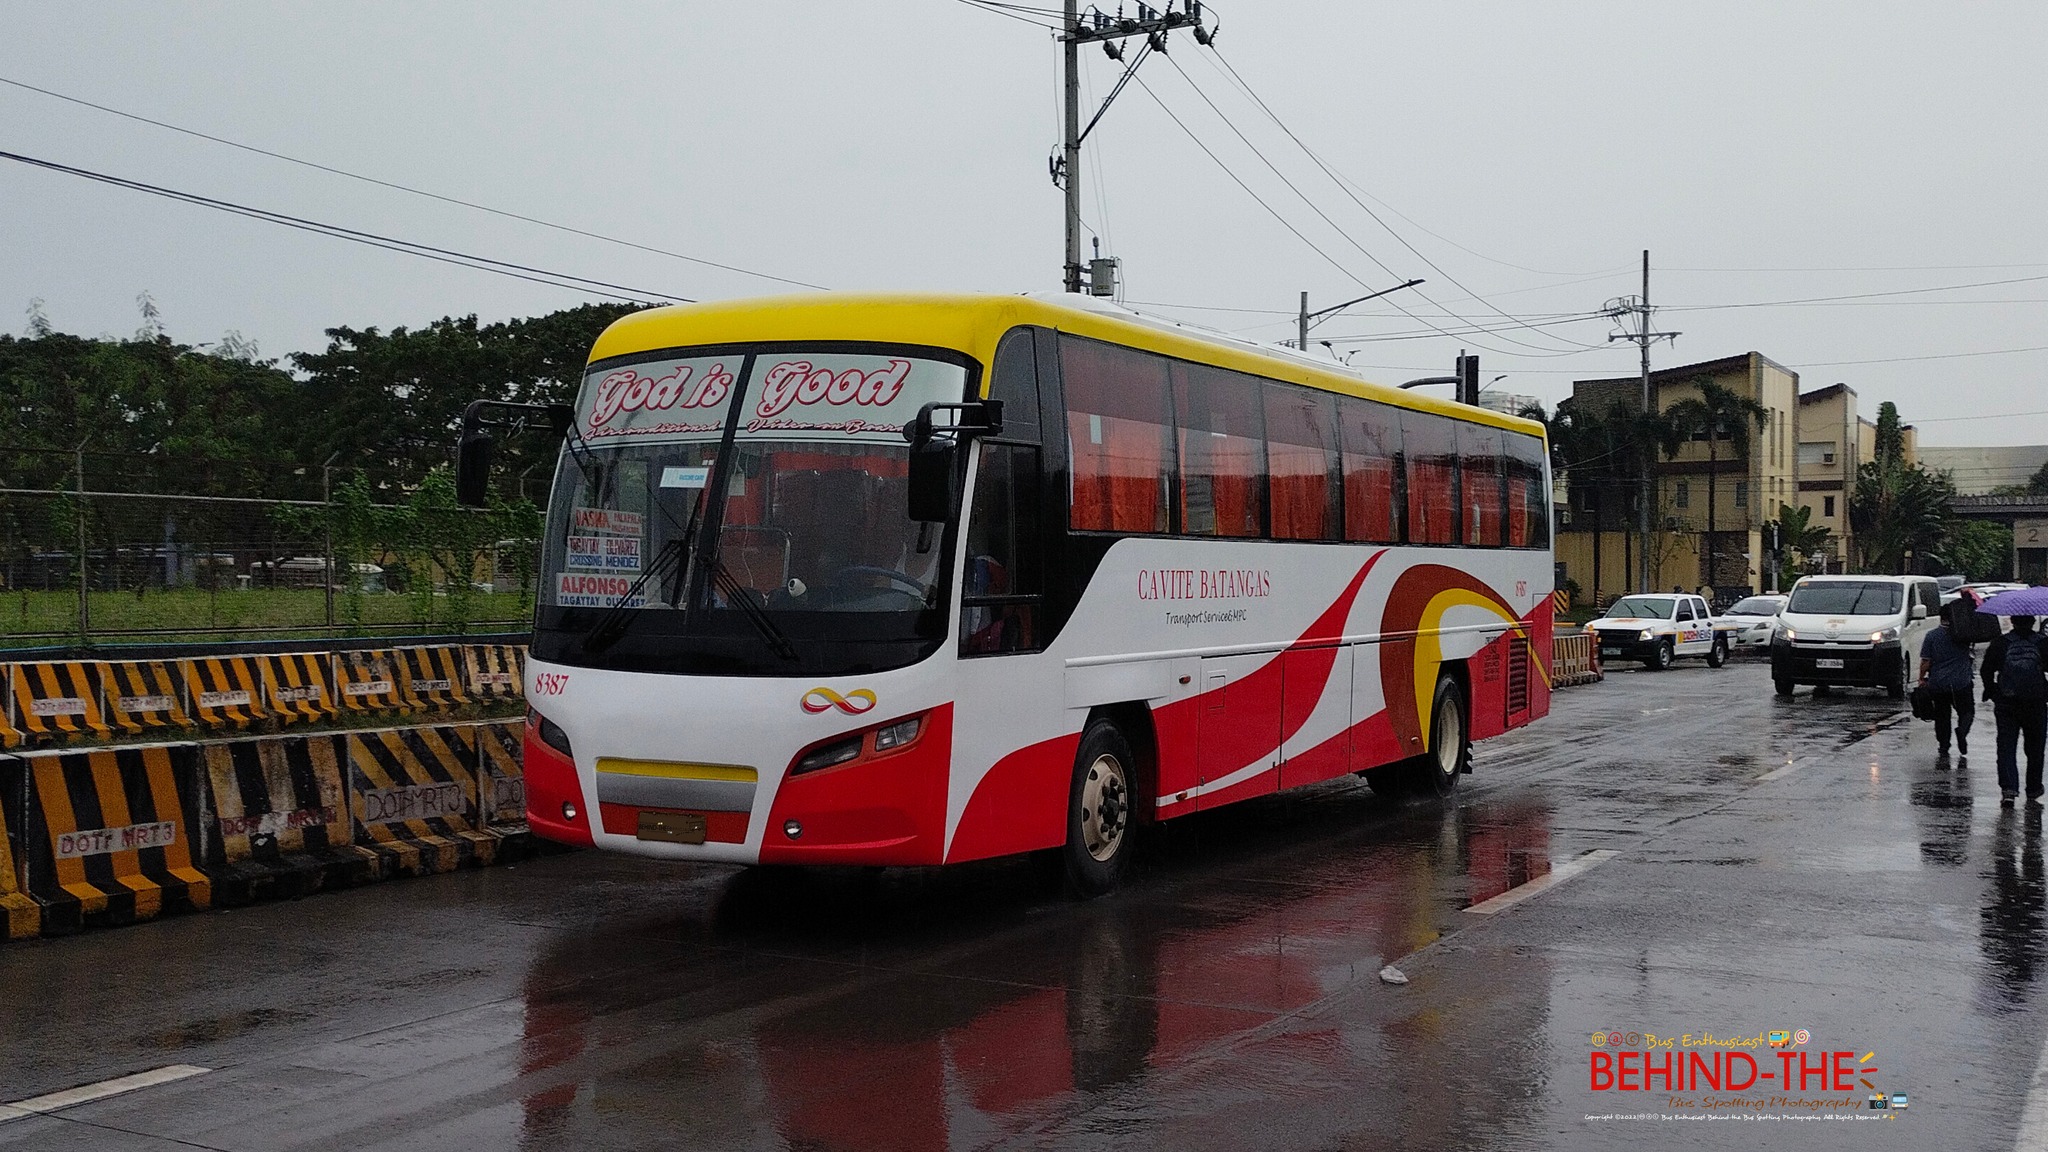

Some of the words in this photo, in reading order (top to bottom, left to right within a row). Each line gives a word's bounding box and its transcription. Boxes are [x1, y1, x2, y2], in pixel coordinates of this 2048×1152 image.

[589, 365, 693, 428] God
[681, 363, 734, 408] is
[756, 360, 912, 418] Good
[580, 421, 721, 441] Airconditioned
[746, 419, 813, 433] Video
[2028, 528, 2039, 542] 2
[605, 556, 639, 569] MENDEZ
[561, 576, 629, 596] ALFONSO
[1138, 569, 1194, 600] CAVITE
[1199, 569, 1270, 599] BATANGAS
[559, 596, 600, 606] TAGAYTAY
[535, 673, 569, 695] 8387
